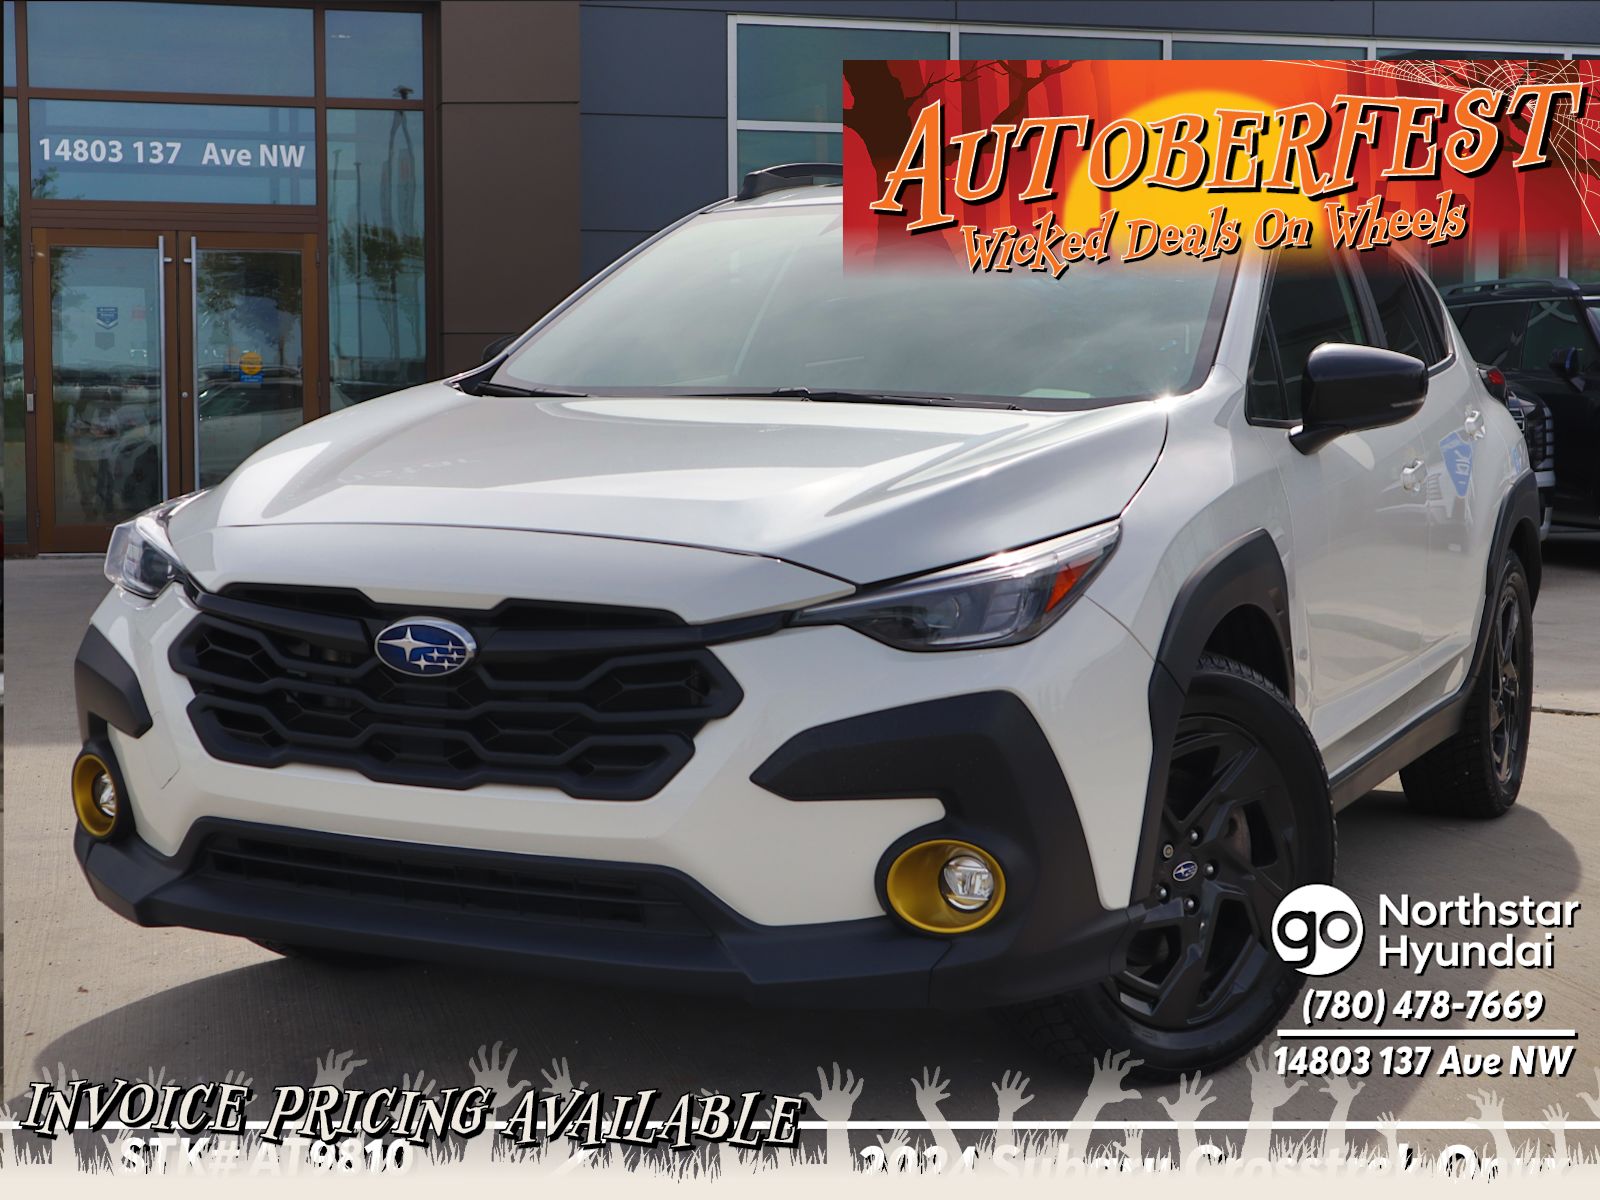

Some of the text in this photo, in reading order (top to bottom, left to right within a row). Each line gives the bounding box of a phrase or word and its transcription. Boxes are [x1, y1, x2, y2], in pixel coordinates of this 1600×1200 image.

[38, 137, 306, 168] 14803 137 Ave NW
